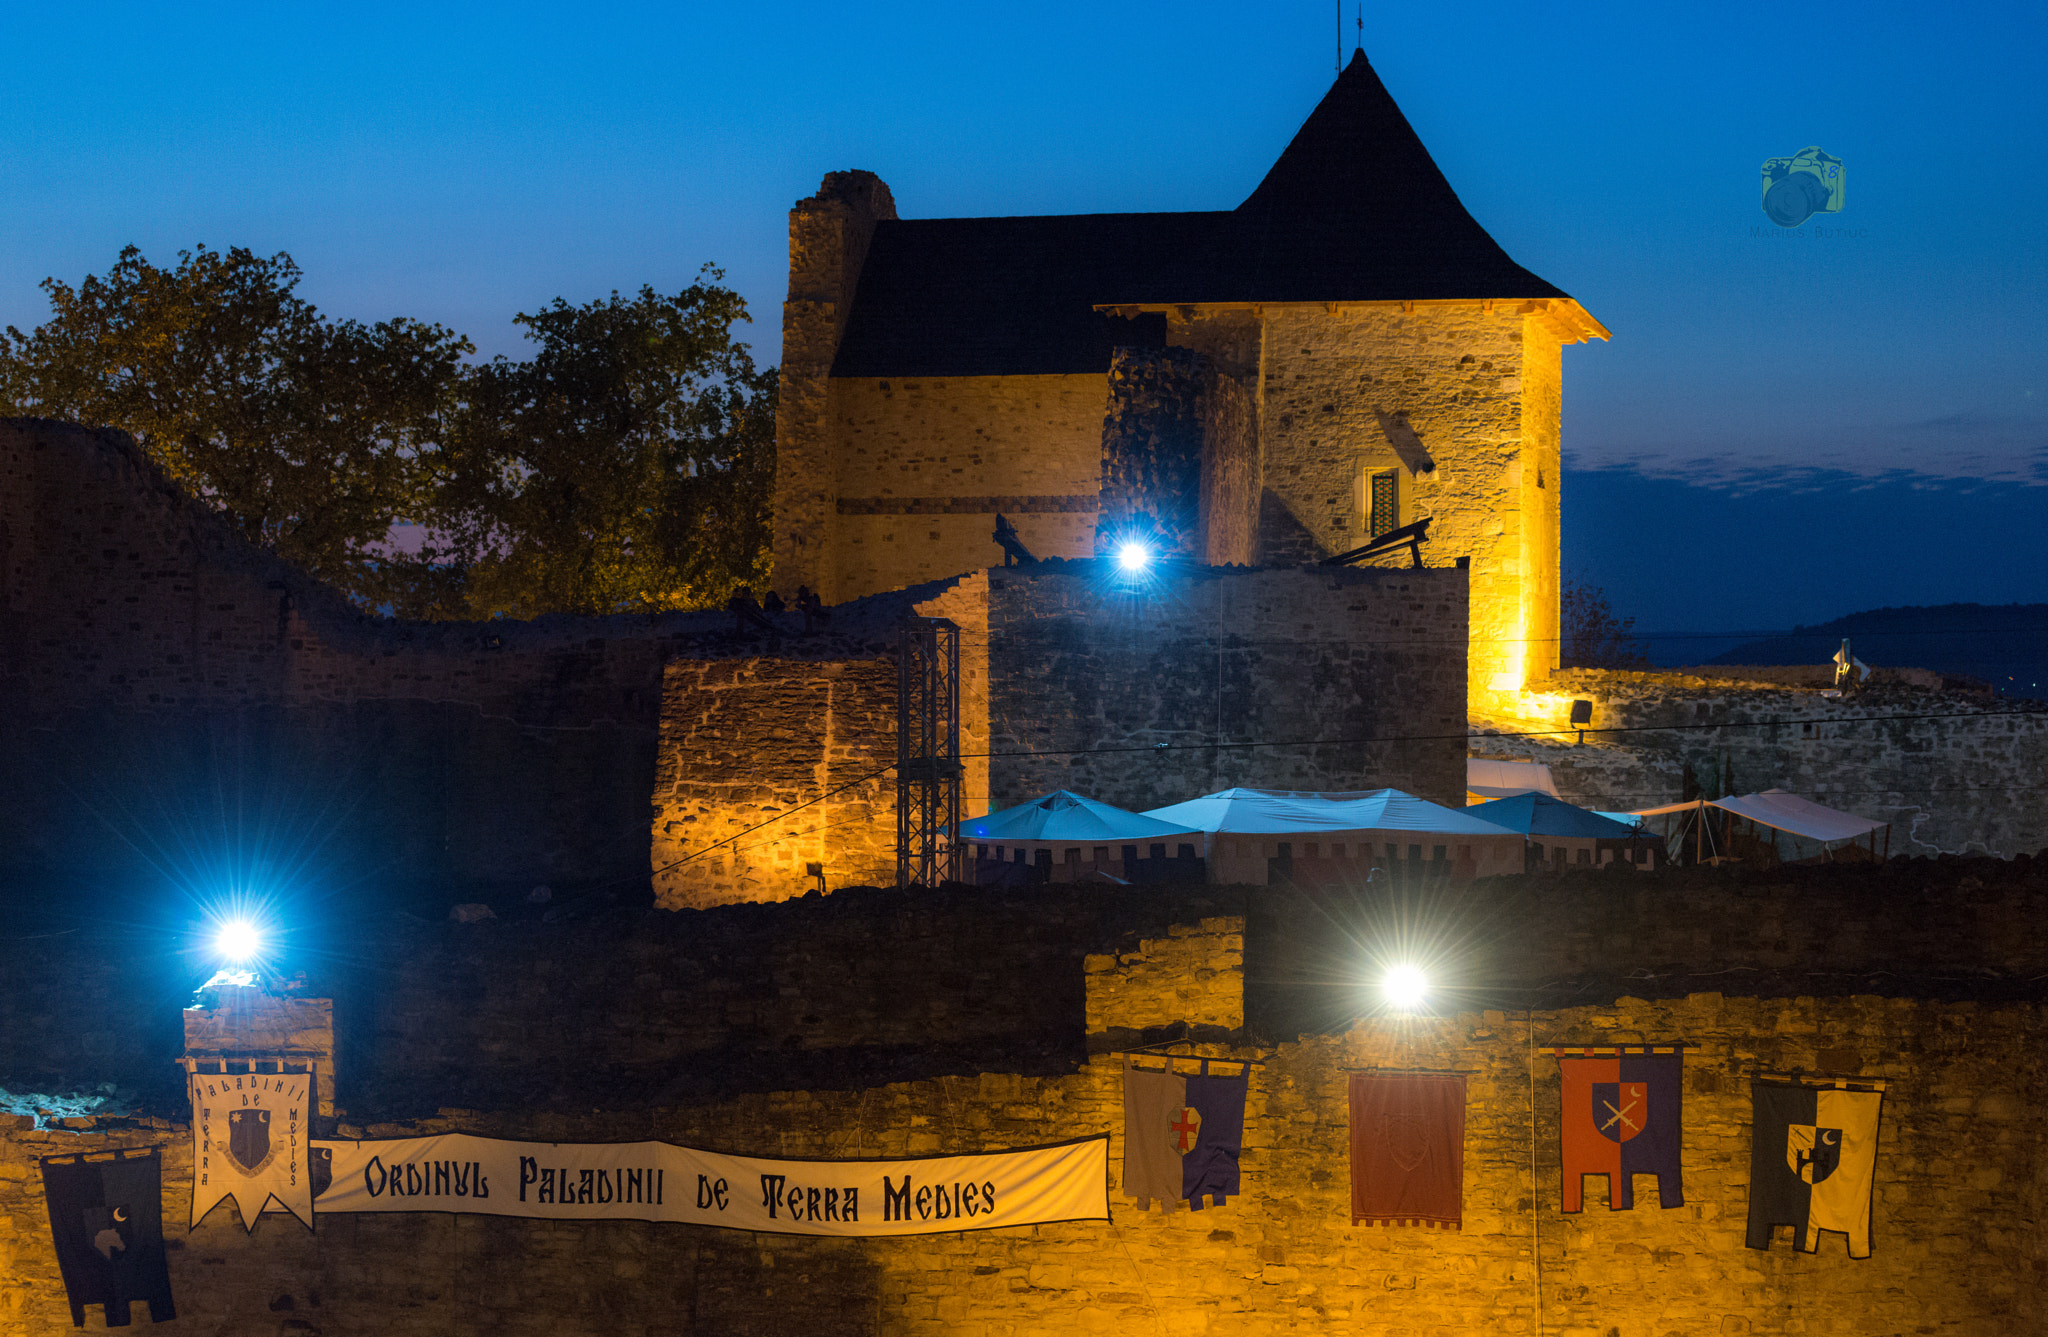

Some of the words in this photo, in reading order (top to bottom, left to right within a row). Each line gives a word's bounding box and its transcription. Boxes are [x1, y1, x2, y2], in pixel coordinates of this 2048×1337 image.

[364, 1155, 489, 1198] ORDINUL
[519, 1156, 664, 1205] PALADINII
[697, 1173, 729, 1211] DE
[760, 1174, 859, 1222] TERRA
[883, 1174, 995, 1222] MEDIES
